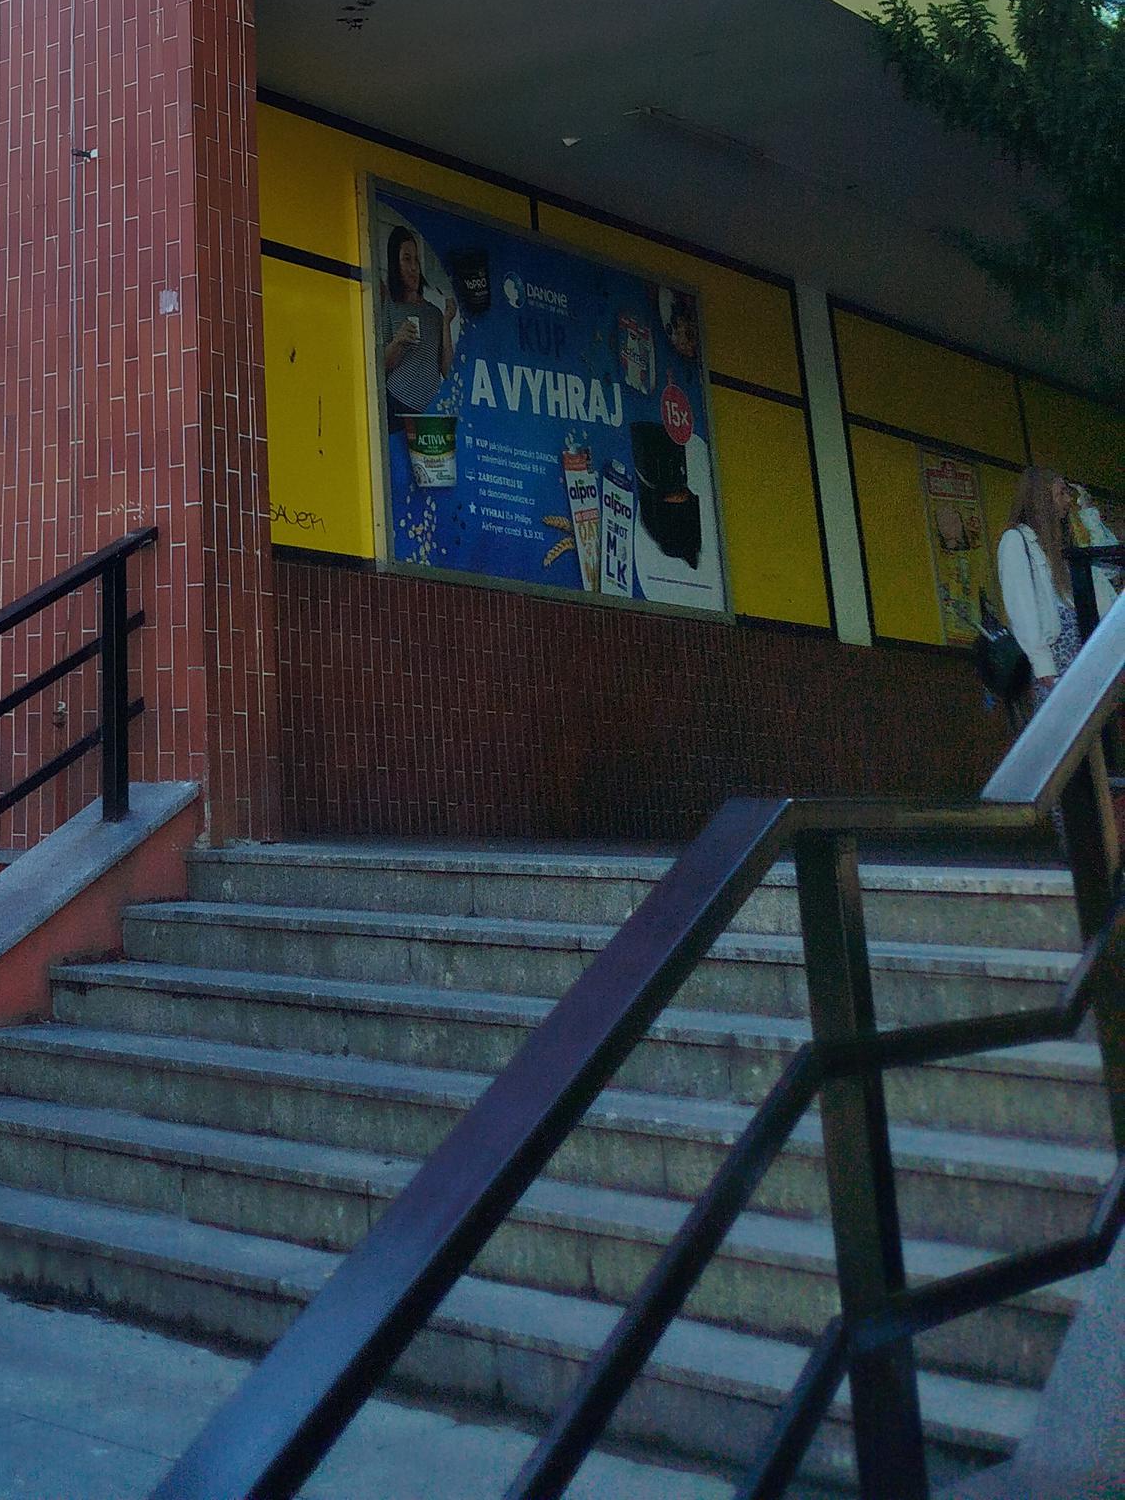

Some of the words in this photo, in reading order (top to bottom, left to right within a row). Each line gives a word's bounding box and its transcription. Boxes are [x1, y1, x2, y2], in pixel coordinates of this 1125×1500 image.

[471, 358, 497, 408] A
[497, 361, 623, 428] VYHRAJ
[664, 400, 690, 428] 15x
[417, 433, 446, 446] ACTIVIA
[475, 437, 488, 448] KUP
[569, 480, 597, 504] alpro
[480, 506, 505, 520] VYHRAJ
[604, 491, 632, 519] alpro
